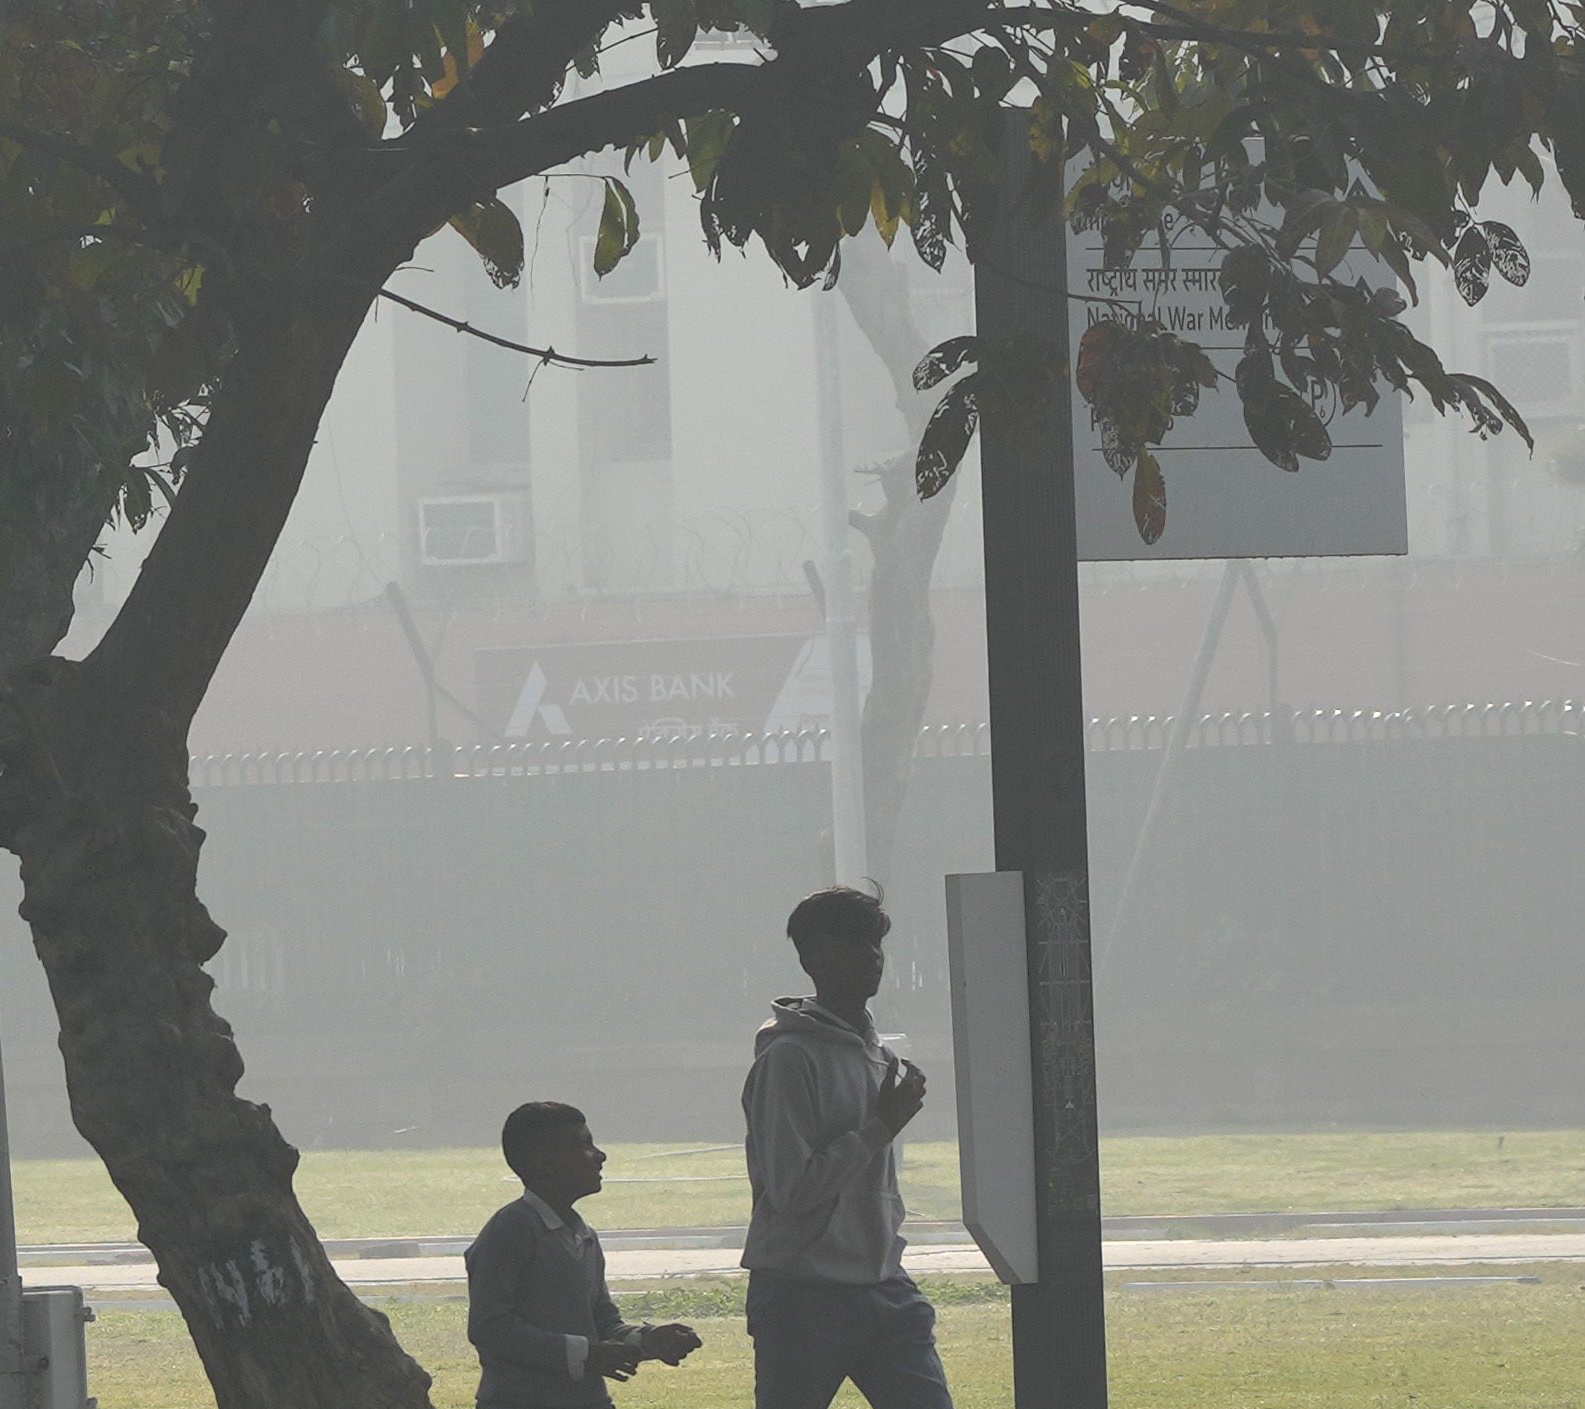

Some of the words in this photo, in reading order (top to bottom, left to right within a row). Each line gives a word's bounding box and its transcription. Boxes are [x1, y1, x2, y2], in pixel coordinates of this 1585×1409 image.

[1183, 268, 1222, 293] स्मार
[1167, 305, 1204, 331] War
[569, 675, 639, 704] AXIS
[650, 672, 735, 702] BANK
